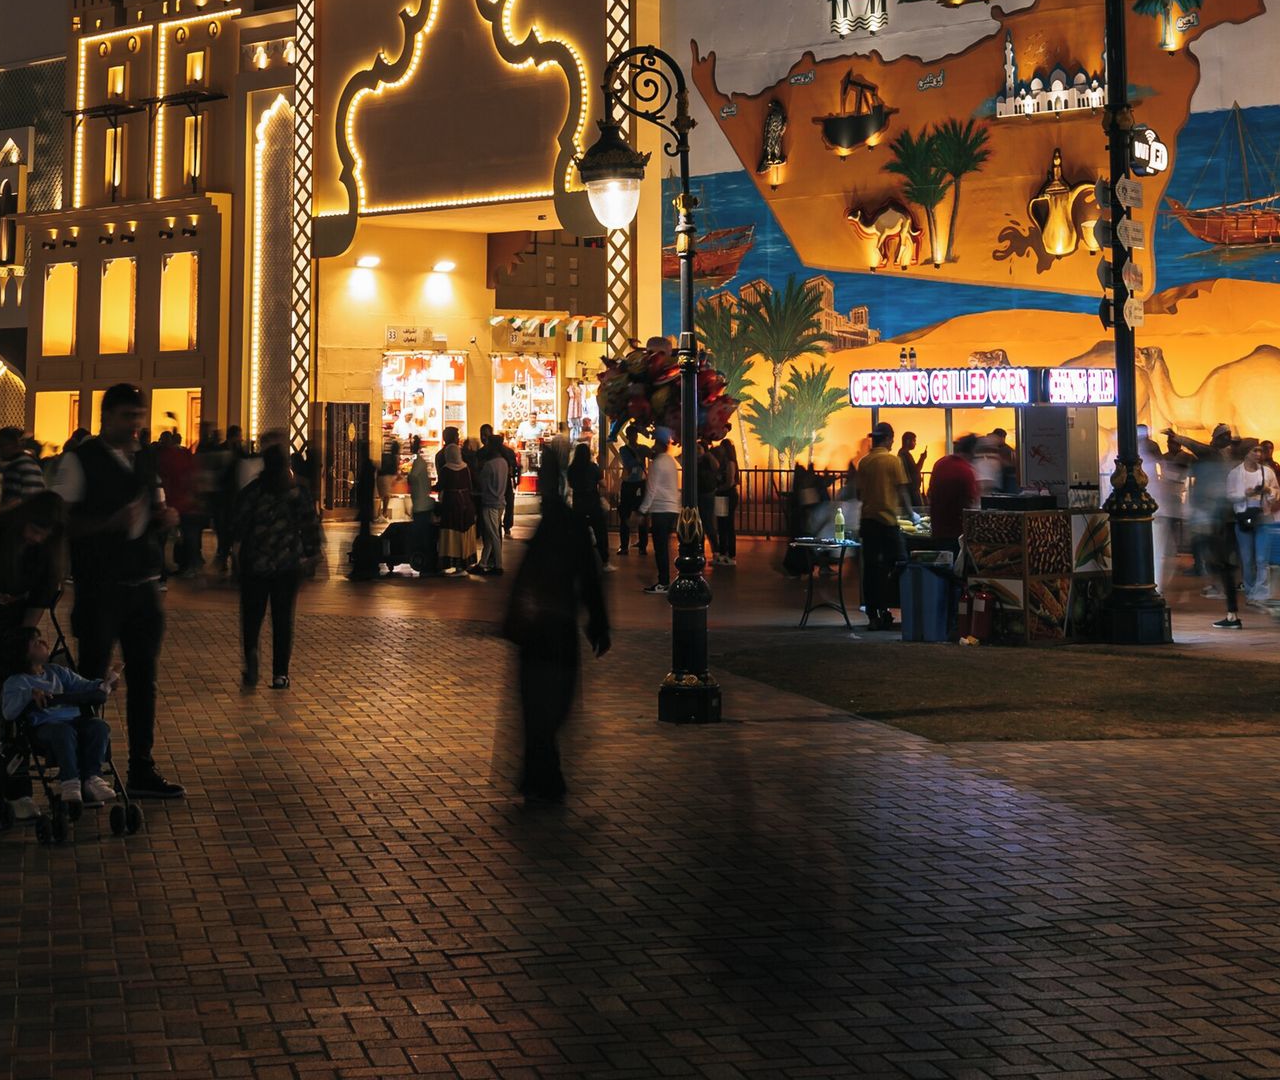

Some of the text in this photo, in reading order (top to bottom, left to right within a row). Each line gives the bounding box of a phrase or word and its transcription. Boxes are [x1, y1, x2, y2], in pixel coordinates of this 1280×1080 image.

[389, 330, 397, 339] 33
[850, 368, 1029, 405] CHESTNUTS GRILLED CORN
